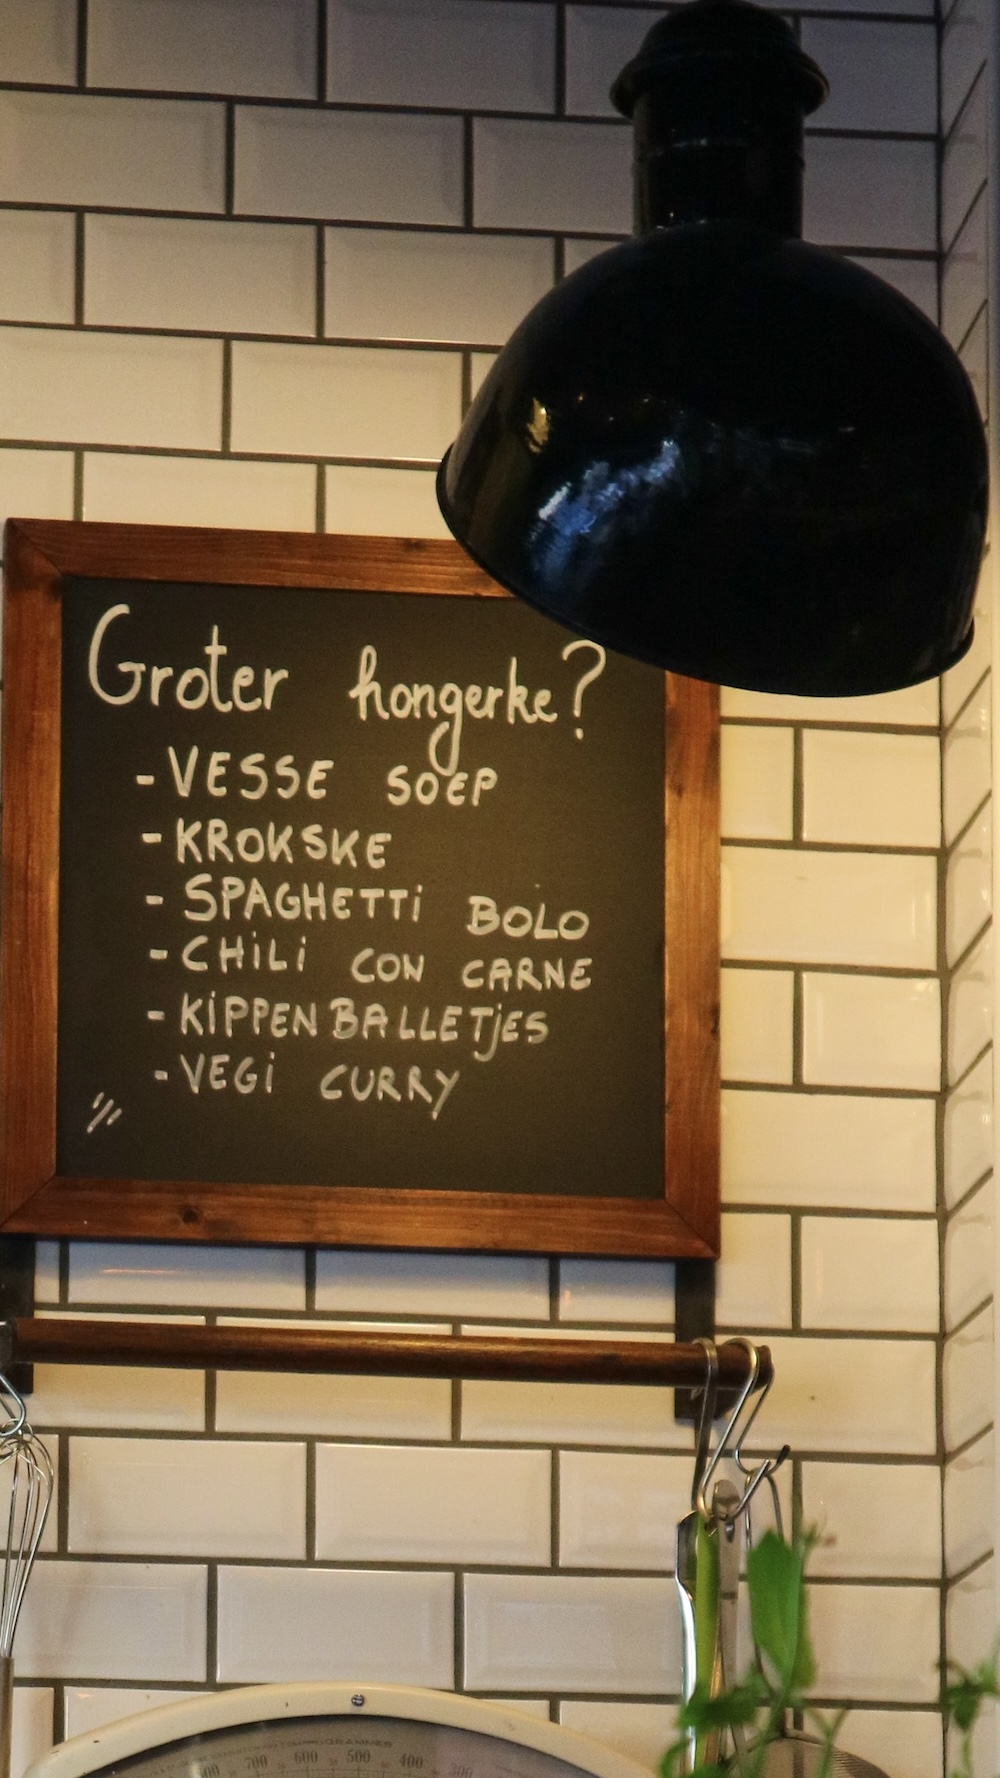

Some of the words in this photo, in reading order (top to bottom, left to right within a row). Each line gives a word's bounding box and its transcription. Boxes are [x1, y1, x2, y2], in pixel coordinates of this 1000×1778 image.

[89, 604, 288, 712] Groter
[168, 746, 334, 799] VESSE
[387, 765, 498, 807] SOEP
[177, 818, 392, 869] KROKSKE
[466, 896, 589, 940] BOLO
[351, 948, 424, 983] CON
[462, 957, 592, 992] CARNE
[321, 1065, 459, 1120] CURRY
[244, 1755, 268, 1770] 700
[294, 1750, 318, 1764] 600
[346, 1749, 371, 1763] 500
[399, 1753, 424, 1769] 400
